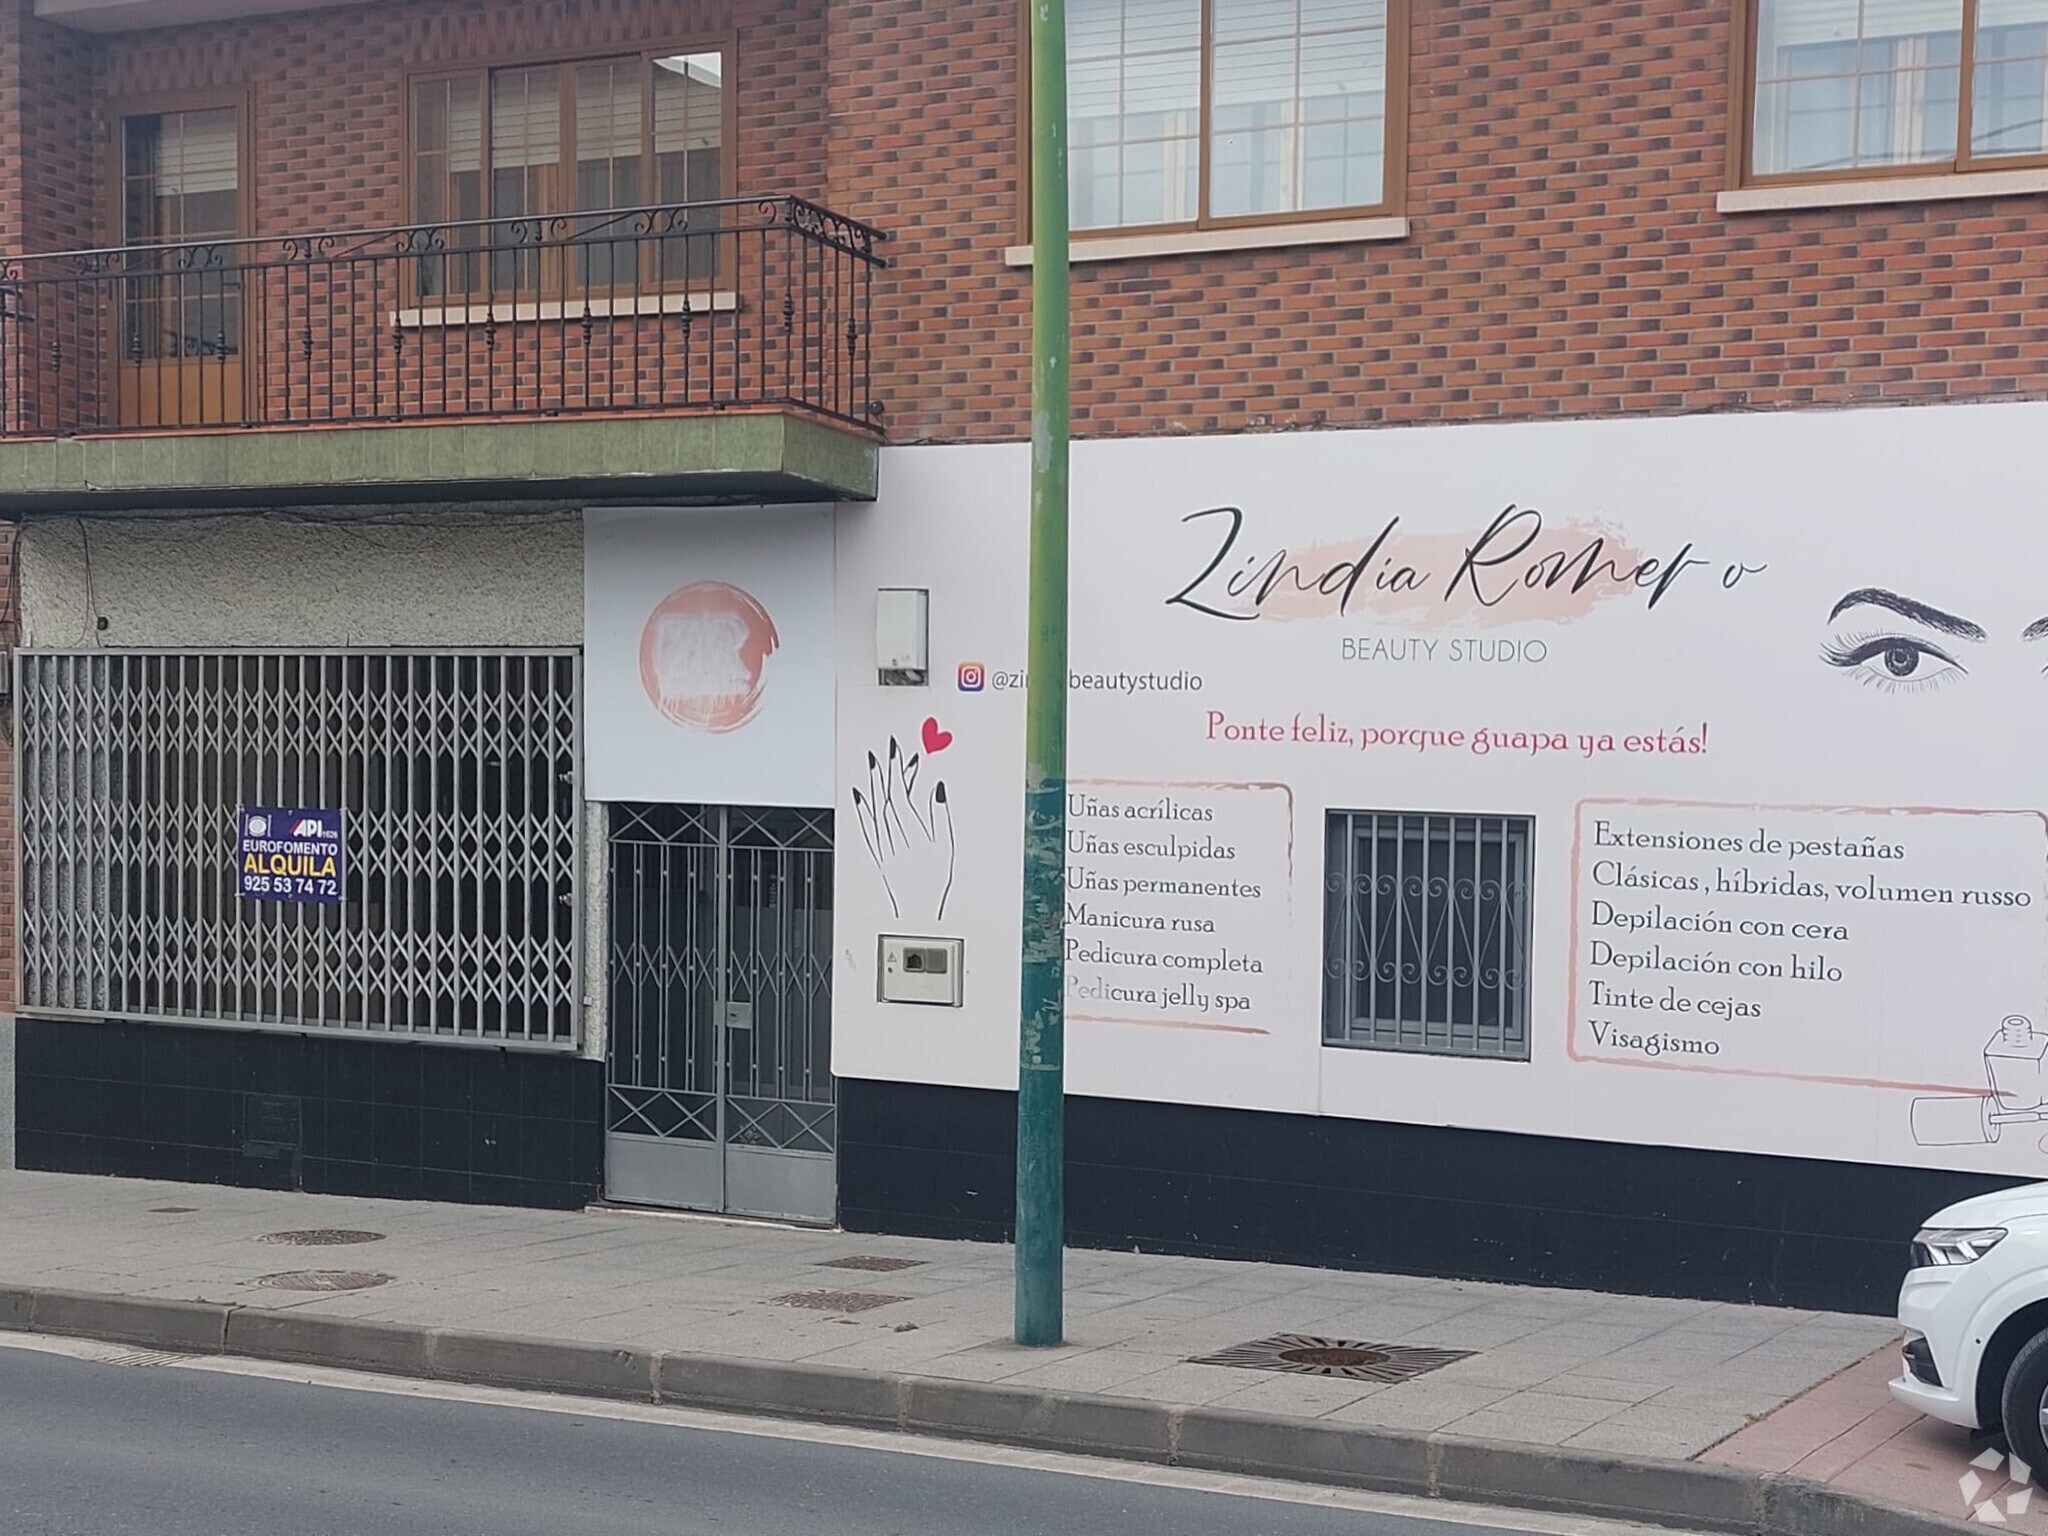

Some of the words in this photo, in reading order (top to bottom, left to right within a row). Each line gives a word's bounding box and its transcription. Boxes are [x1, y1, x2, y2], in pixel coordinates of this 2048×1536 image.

[1164, 506, 1432, 621] Zindia
[1341, 637, 1439, 662] BEAUTY
[1448, 638, 1548, 663] STUDIO
[1206, 710, 1285, 742] Ponte
[1291, 712, 1354, 748] feliz,
[1360, 727, 1465, 753] porque
[1470, 728, 1570, 757] guapa
[1577, 734, 1616, 759] ya
[1623, 721, 1708, 755] estás!
[1067, 792, 1120, 819] Uñas
[1123, 796, 1214, 822] acrílicas
[243, 840, 338, 855] EUROFOMENTO
[293, 819, 322, 838] API
[1066, 829, 1120, 855] Uñas
[1123, 833, 1236, 863] esculpidas
[1593, 819, 1744, 853] Extensiones
[1748, 826, 1783, 855] de
[1787, 835, 1905, 862] pestañas
[244, 853, 337, 877] ALQUILA
[1066, 865, 1119, 891] Uñas
[1122, 877, 1262, 899] permanentes
[243, 876, 271, 892] 925
[273, 877, 293, 894] 53
[295, 878, 314, 895] 74
[317, 879, 337, 895] 72
[1714, 866, 1830, 901] híbridas,
[1834, 873, 1954, 904] volumen
[1960, 889, 2032, 907] russo
[1063, 901, 1167, 932] Manicura
[1170, 917, 1217, 934] rusa
[1590, 899, 1733, 935] Depilación
[1739, 917, 1786, 938] con
[1791, 923, 1851, 944] cera
[1064, 937, 1159, 967] Pedicura
[1162, 947, 1264, 976] completa
[1589, 939, 1732, 975] Depilación
[1737, 961, 1784, 978] con
[1788, 952, 1843, 982] hilo
[1066, 975, 1157, 1004] Pedicura
[1159, 981, 1209, 1013] jelly
[1213, 994, 1252, 1015] spa
[1588, 979, 1654, 1010] Tinte
[1658, 984, 1692, 1013] de
[1694, 996, 1762, 1022] cejas
[1587, 1019, 1720, 1058] Visagismo
